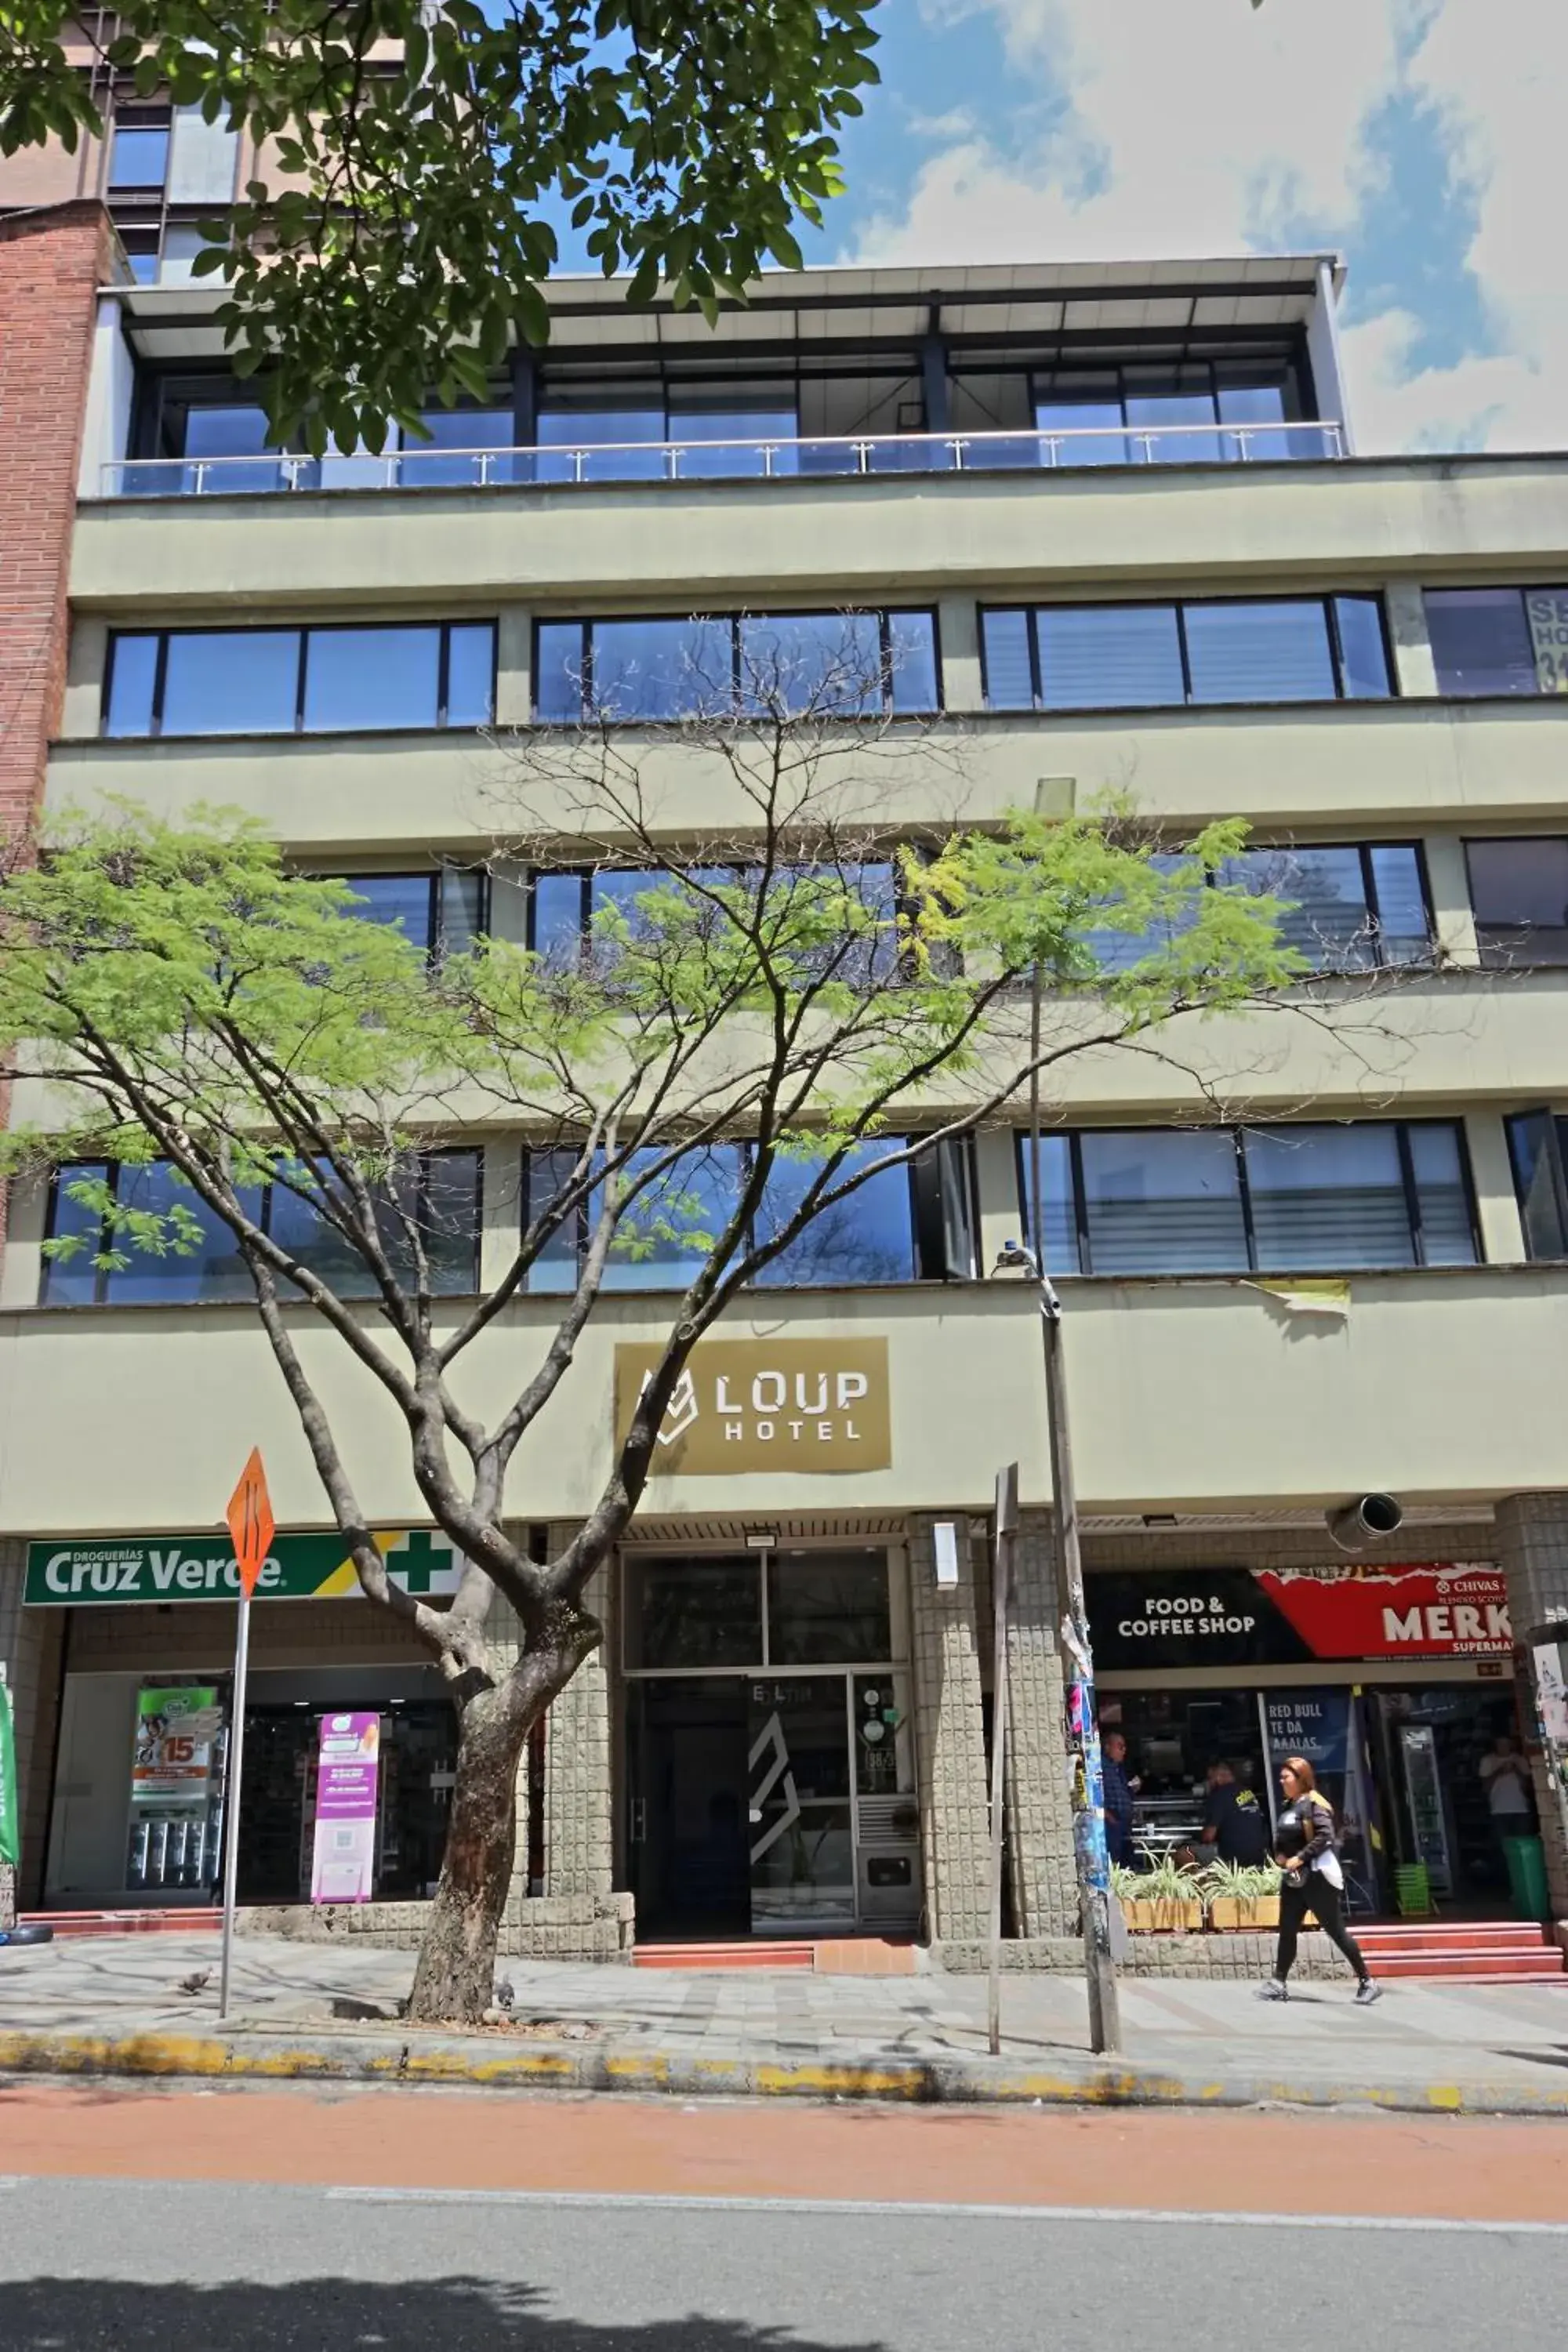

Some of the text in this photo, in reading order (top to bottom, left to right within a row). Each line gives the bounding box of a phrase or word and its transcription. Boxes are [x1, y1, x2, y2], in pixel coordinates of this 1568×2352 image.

[717, 1371, 867, 1414] LOUP
[724, 1421, 861, 1440] HOTEL
[73, 1548, 143, 1562] DROGUERÍAS
[45, 1552, 143, 1593] Cruz
[1454, 1580, 1500, 1592] CHIVAS
[1145, 1596, 1225, 1614] FOOD &
[1118, 1617, 1255, 1636] COFFEE SHOP
[1382, 1605, 1513, 1641] MERK
[1453, 1642, 1514, 1653] SUPERMA
[1269, 1704, 1323, 1718] RED BULL
[1271, 1721, 1303, 1734] TE DA
